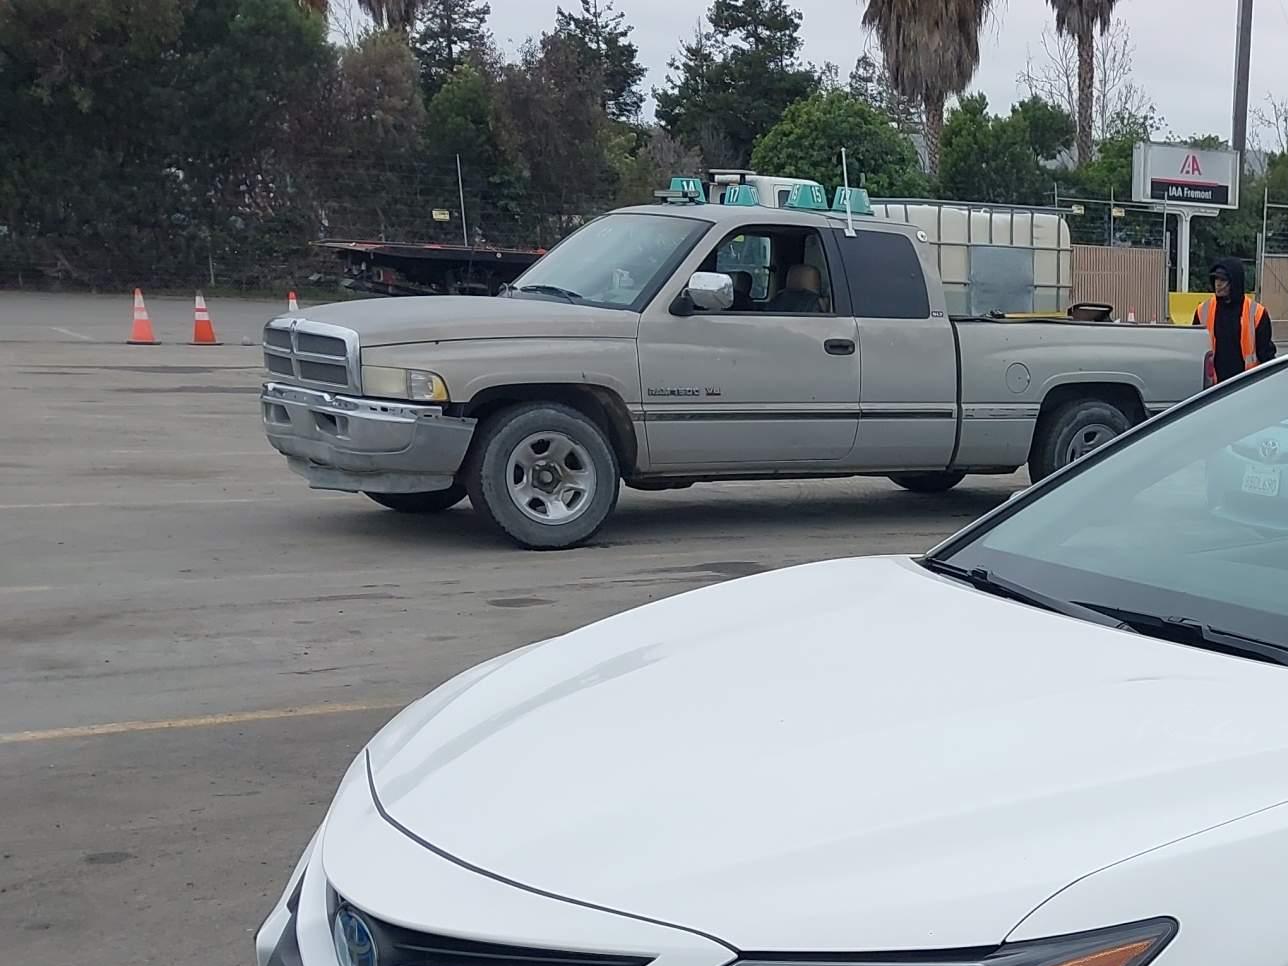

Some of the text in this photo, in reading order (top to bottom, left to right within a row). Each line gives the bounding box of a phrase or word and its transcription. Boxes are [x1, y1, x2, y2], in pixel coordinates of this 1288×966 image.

[730, 187, 740, 203] 17
[811, 186, 822, 203] 15
[1168, 185, 1212, 199] IAA Fremont
